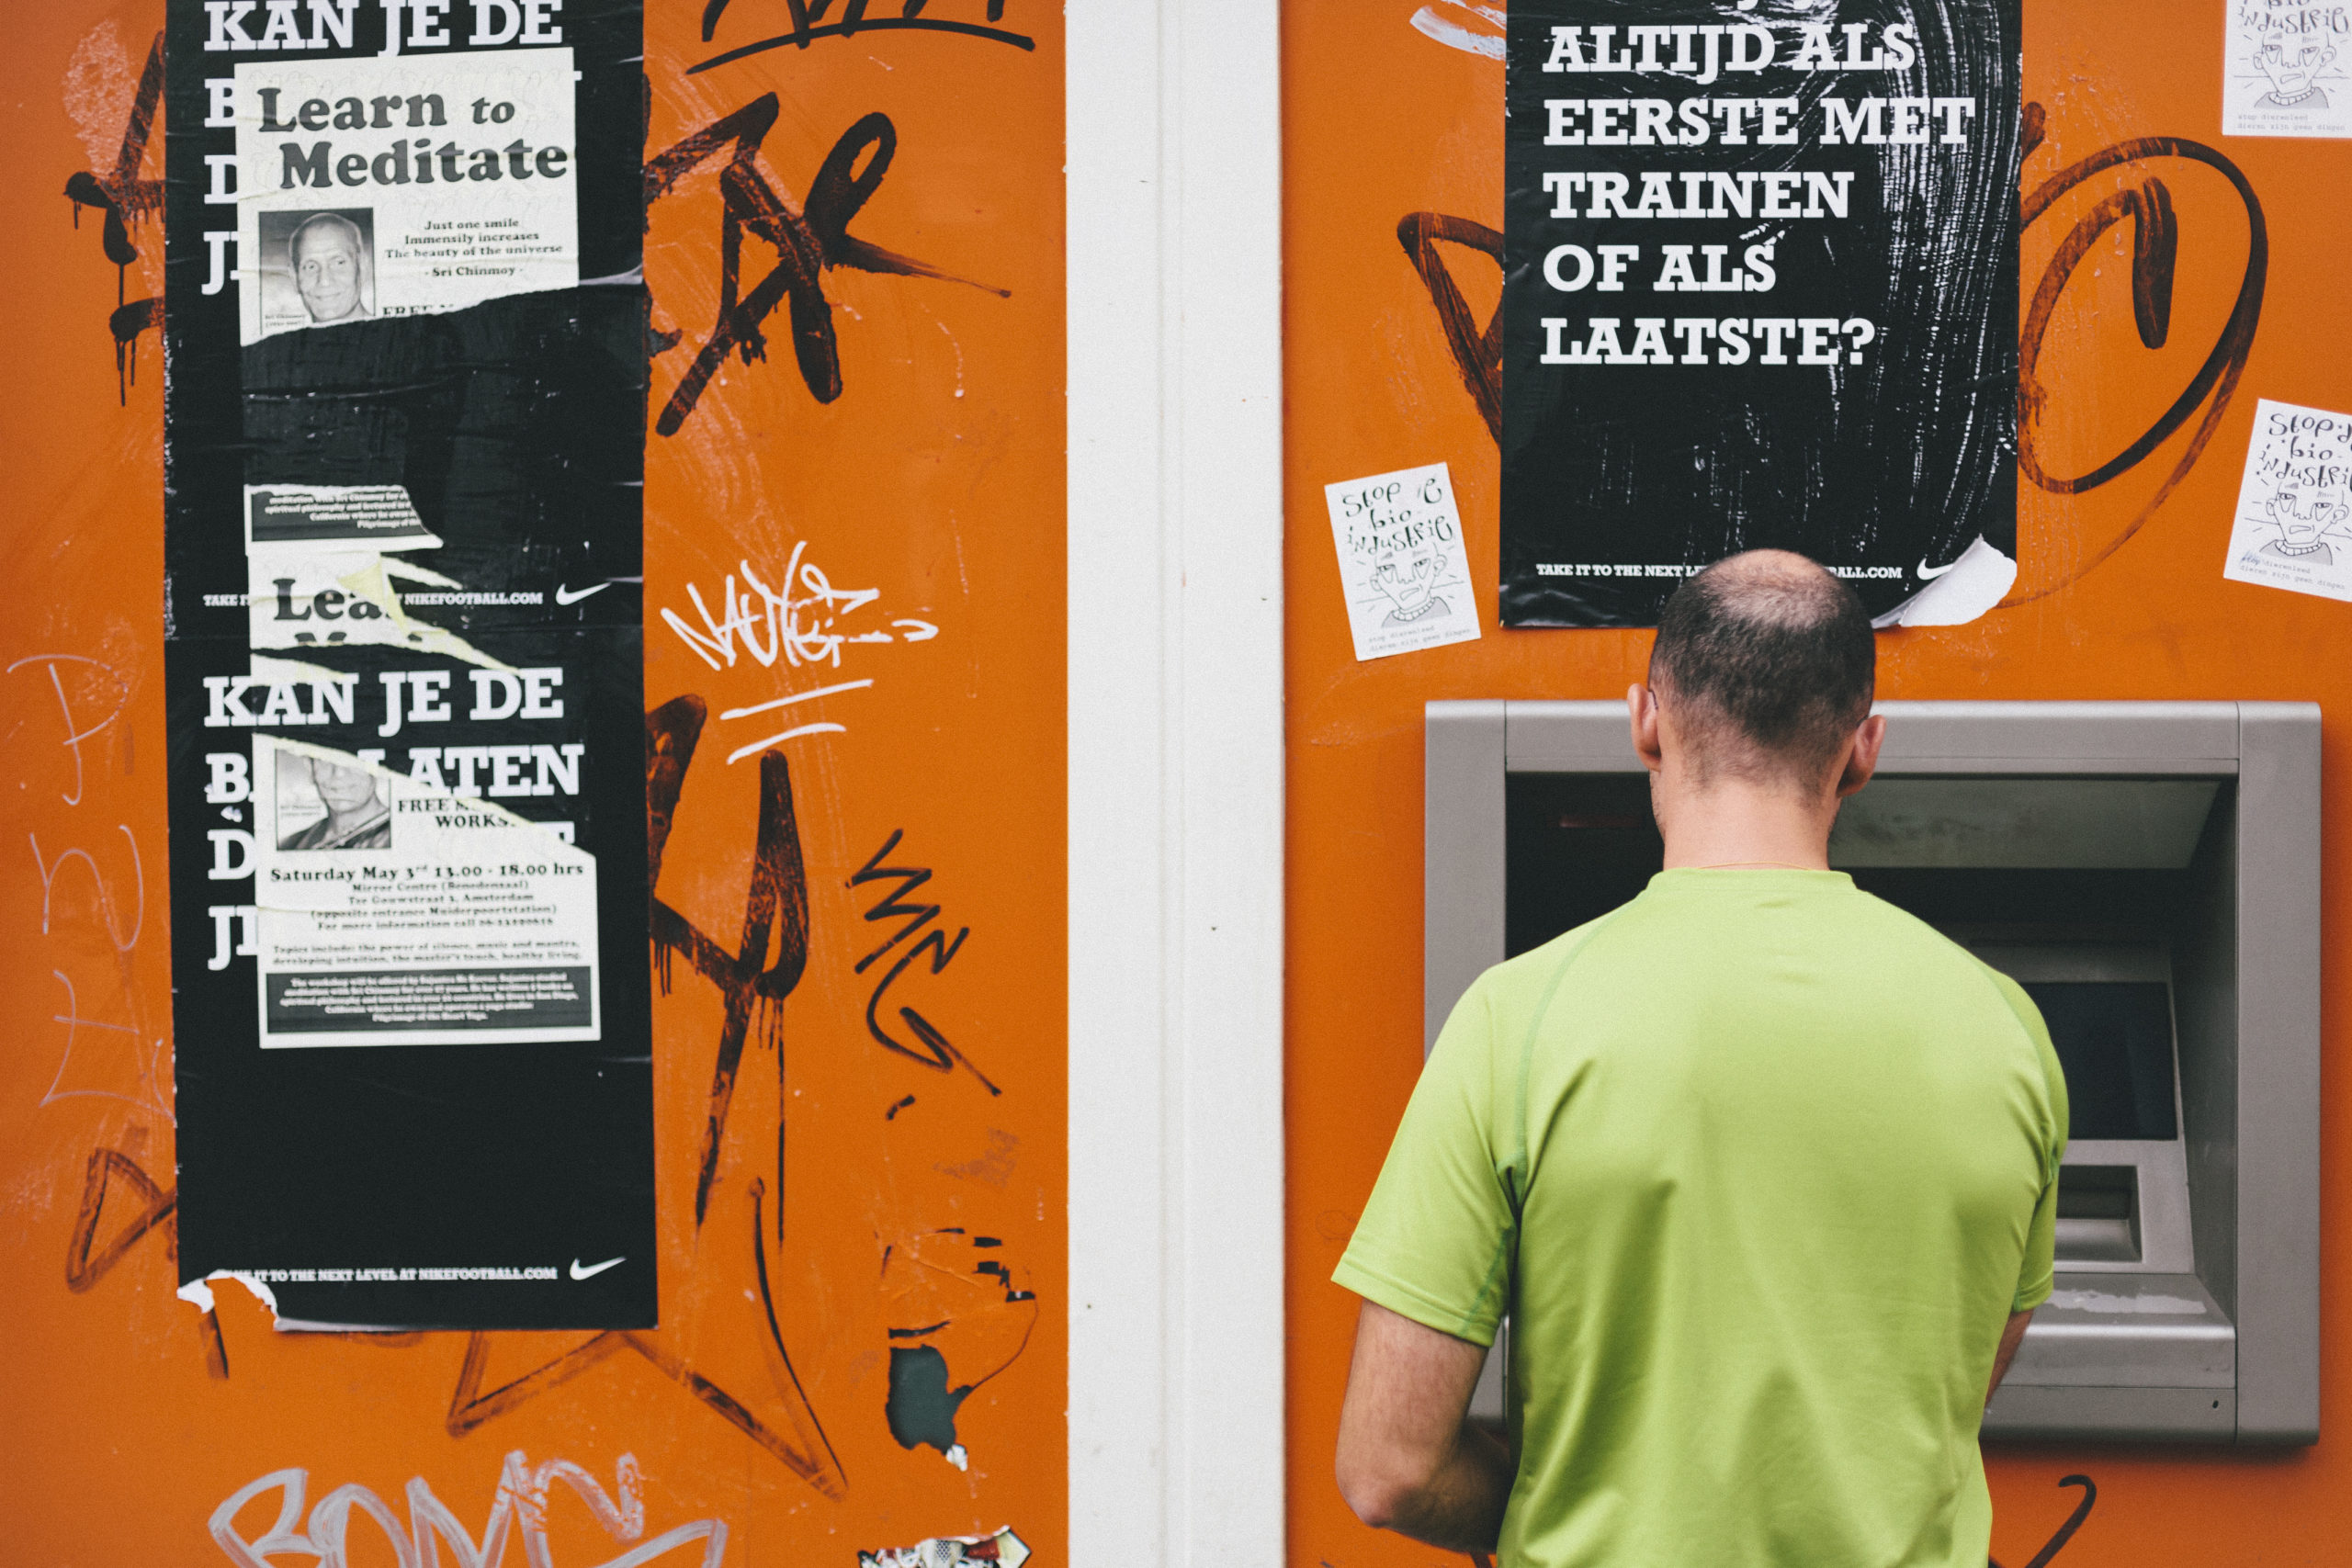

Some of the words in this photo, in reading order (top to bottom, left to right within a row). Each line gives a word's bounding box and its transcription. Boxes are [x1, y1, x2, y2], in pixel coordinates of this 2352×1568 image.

[204, 0, 359, 51] KAN
[378, 0, 450, 57] JE
[469, 0, 562, 45] DE
[1542, 25, 1775, 85] ALTIJD
[1792, 23, 1916, 71] ALS
[257, 88, 447, 133] Learn
[469, 96, 515, 126] to
[1544, 97, 1799, 145] EERSTE
[1819, 97, 1974, 144] MET
[279, 139, 568, 189] Meditate
[1543, 172, 1854, 218] TRAINEN
[424, 220, 453, 230] Just
[484, 219, 519, 228] smile
[479, 232, 539, 242] increases
[386, 249, 409, 258] The
[413, 248, 458, 258] beauty
[463, 247, 476, 256] of
[481, 247, 502, 255] the
[506, 244, 562, 254] universe
[432, 266, 452, 276] Sri
[456, 265, 515, 276] Chinmoy
[1543, 244, 1640, 292] OF
[1654, 244, 1776, 292] ALS
[1540, 317, 1874, 365] LAATSTE?
[2269, 413, 2334, 437] Stop
[1342, 482, 1401, 517] Stop
[1536, 563, 1573, 576] TAKE
[1575, 563, 1591, 576] IT
[1592, 563, 1612, 576] TO
[1613, 564, 1643, 577] THE
[1645, 565, 1683, 577] NEXT
[1825, 566, 1903, 579] BALL.COM
[203, 594, 237, 606] TAKE
[273, 579, 393, 621] Lea
[404, 592, 543, 605] NIKEFOOTBALL.COM
[203, 672, 359, 727] KAN
[378, 671, 451, 737] JE
[469, 667, 564, 720] DE
[357, 744, 585, 797] ATEN
[398, 798, 450, 812] FREE
[435, 815, 516, 828] WORKS
[271, 867, 356, 884] Saturday
[363, 866, 399, 882] May
[435, 866, 482, 879] 13.00
[500, 864, 547, 876] 18.00
[554, 863, 583, 874] hrs
[463, 893, 534, 902] Amsterdam
[269, 1269, 288, 1281] TO
[289, 1269, 316, 1281] THE
[318, 1269, 355, 1281] NEXT
[356, 1269, 398, 1281] LEVEL
[399, 1268, 417, 1280] AT
[418, 1268, 558, 1280] NIKEFOOTBALL.COM
